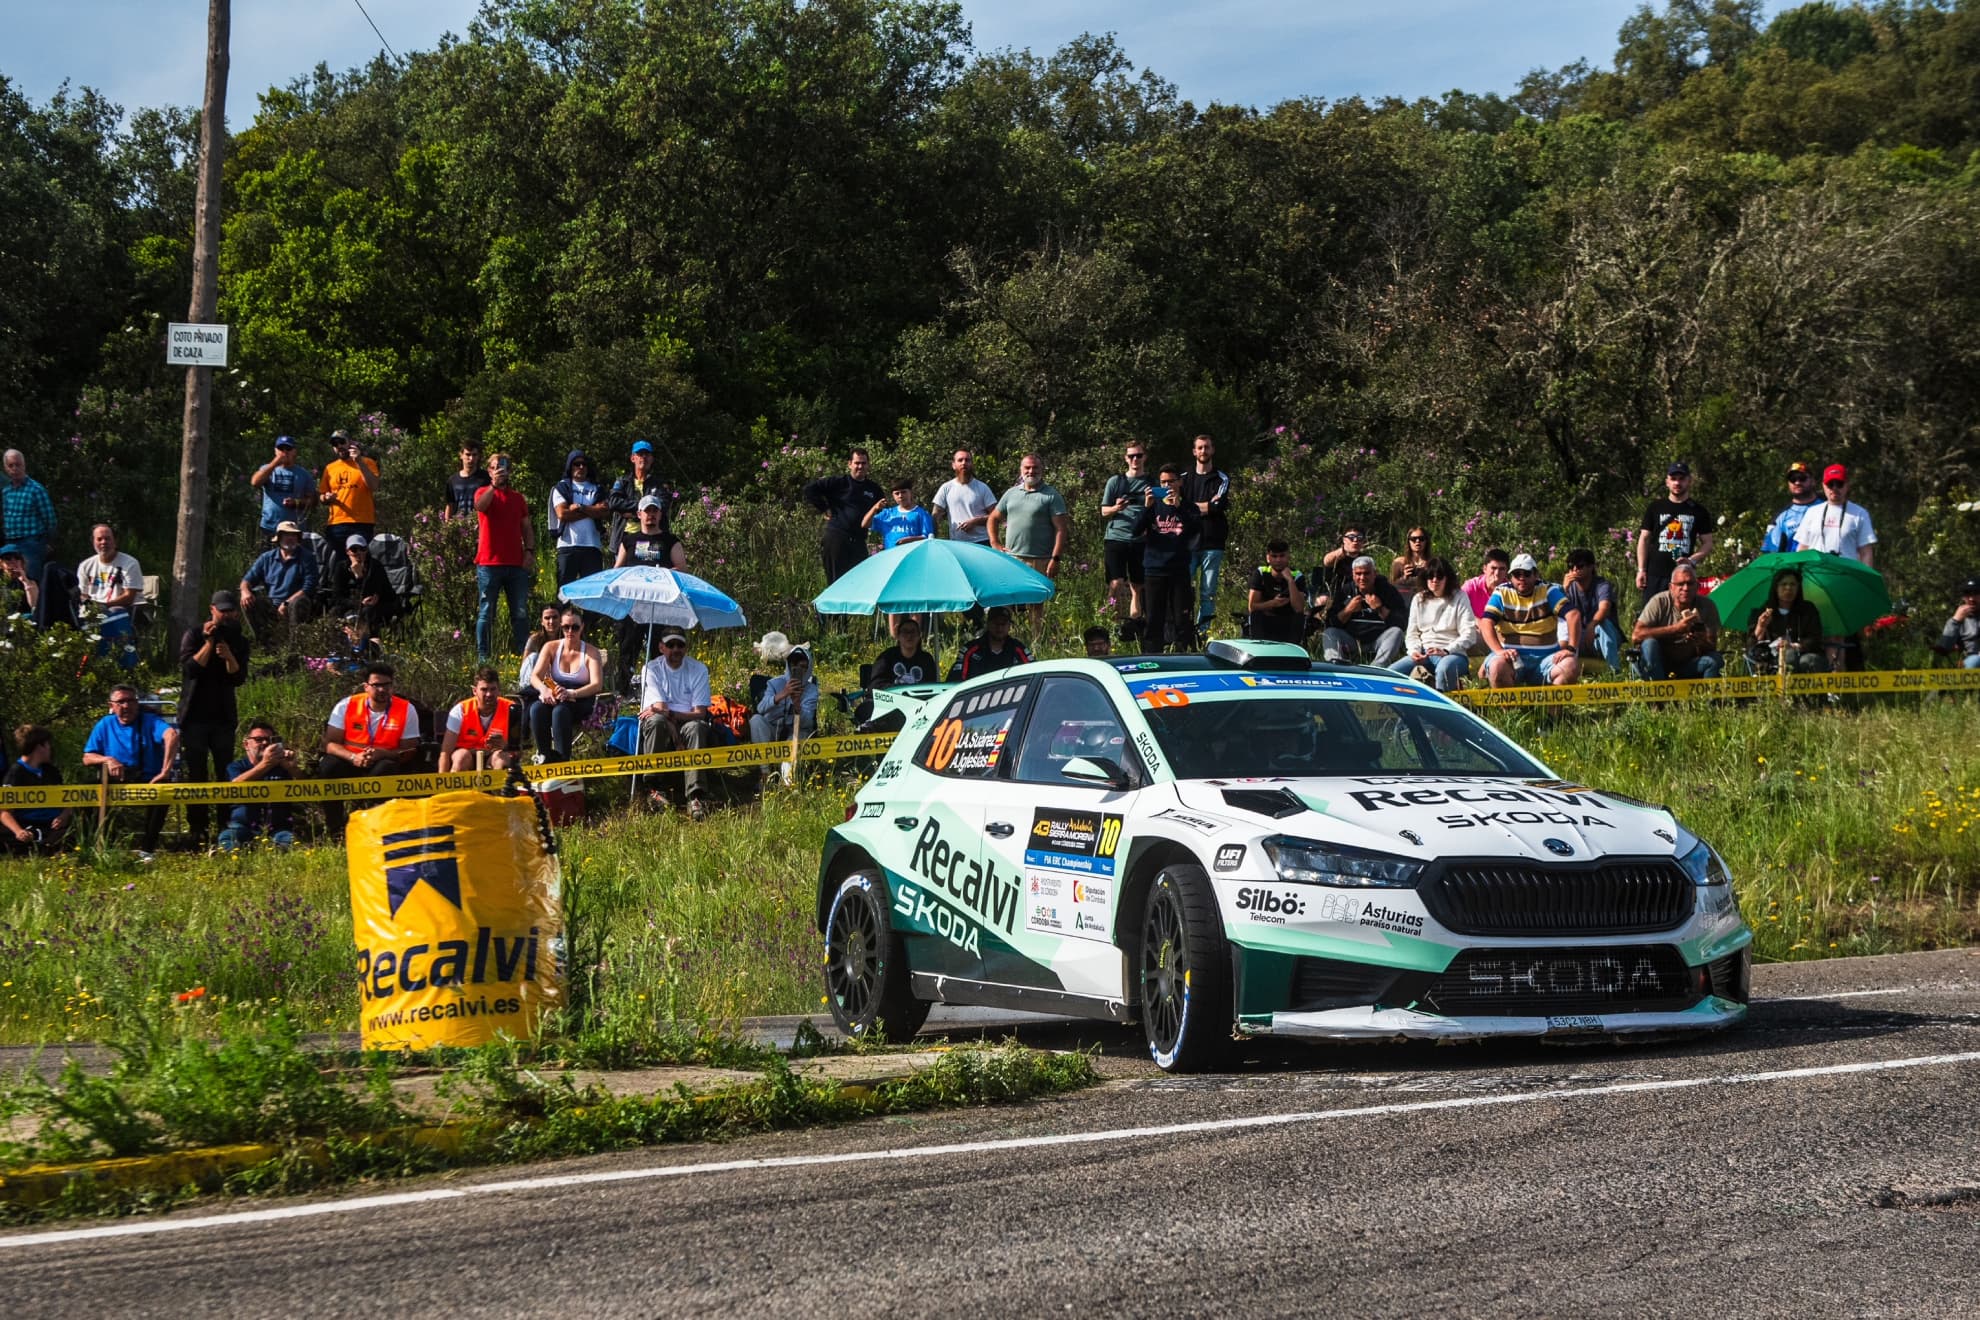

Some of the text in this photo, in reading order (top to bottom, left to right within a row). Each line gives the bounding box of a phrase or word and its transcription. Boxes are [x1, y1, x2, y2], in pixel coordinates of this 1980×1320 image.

[173, 331, 223, 344] COTO PRIVADO
[173, 346, 182, 357] DE
[183, 346, 203, 358] CAZA
[874, 692, 894, 703] SKODA
[1136, 688, 1190, 709] 10
[1484, 692, 1518, 705] ZONA
[1520, 689, 1574, 704] PUBLICO
[1587, 687, 1620, 700] ZONA
[1791, 677, 1824, 690] ZONA
[1827, 675, 1880, 689] PUBLICO
[1892, 674, 1925, 687] ZONA
[925, 718, 963, 771] 10
[1136, 731, 1161, 775] SKODA
[546, 764, 603, 778] PUBLICO
[618, 760, 653, 771] ZONA
[656, 753, 712, 769] PUBLICO
[727, 748, 762, 762] ZONA
[836, 739, 872, 753] ZONA
[62, 789, 99, 803] ZONA
[173, 787, 208, 800] ZONA
[212, 785, 270, 799] PUBLICO
[284, 784, 322, 798] ZONA
[324, 781, 382, 796] PUBLICO
[397, 778, 433, 792] ZONA
[1345, 789, 1611, 811] Recalvi
[1033, 819, 1051, 837] 43
[1050, 820, 1069, 831] RALLY
[1437, 811, 1617, 829] SKODA
[1098, 817, 1121, 855] 10
[1219, 848, 1242, 860] UFI
[909, 815, 1022, 936] Recalvi
[894, 884, 982, 960] SKODA
[1249, 911, 1286, 925] Telecom
[1362, 901, 1424, 928] Asturias
[1359, 918, 1422, 937] paraíso natural
[358, 927, 539, 1002] Recalvi
[1469, 957, 1664, 995] SKODA
[368, 994, 521, 1032] www.recalvi.es
